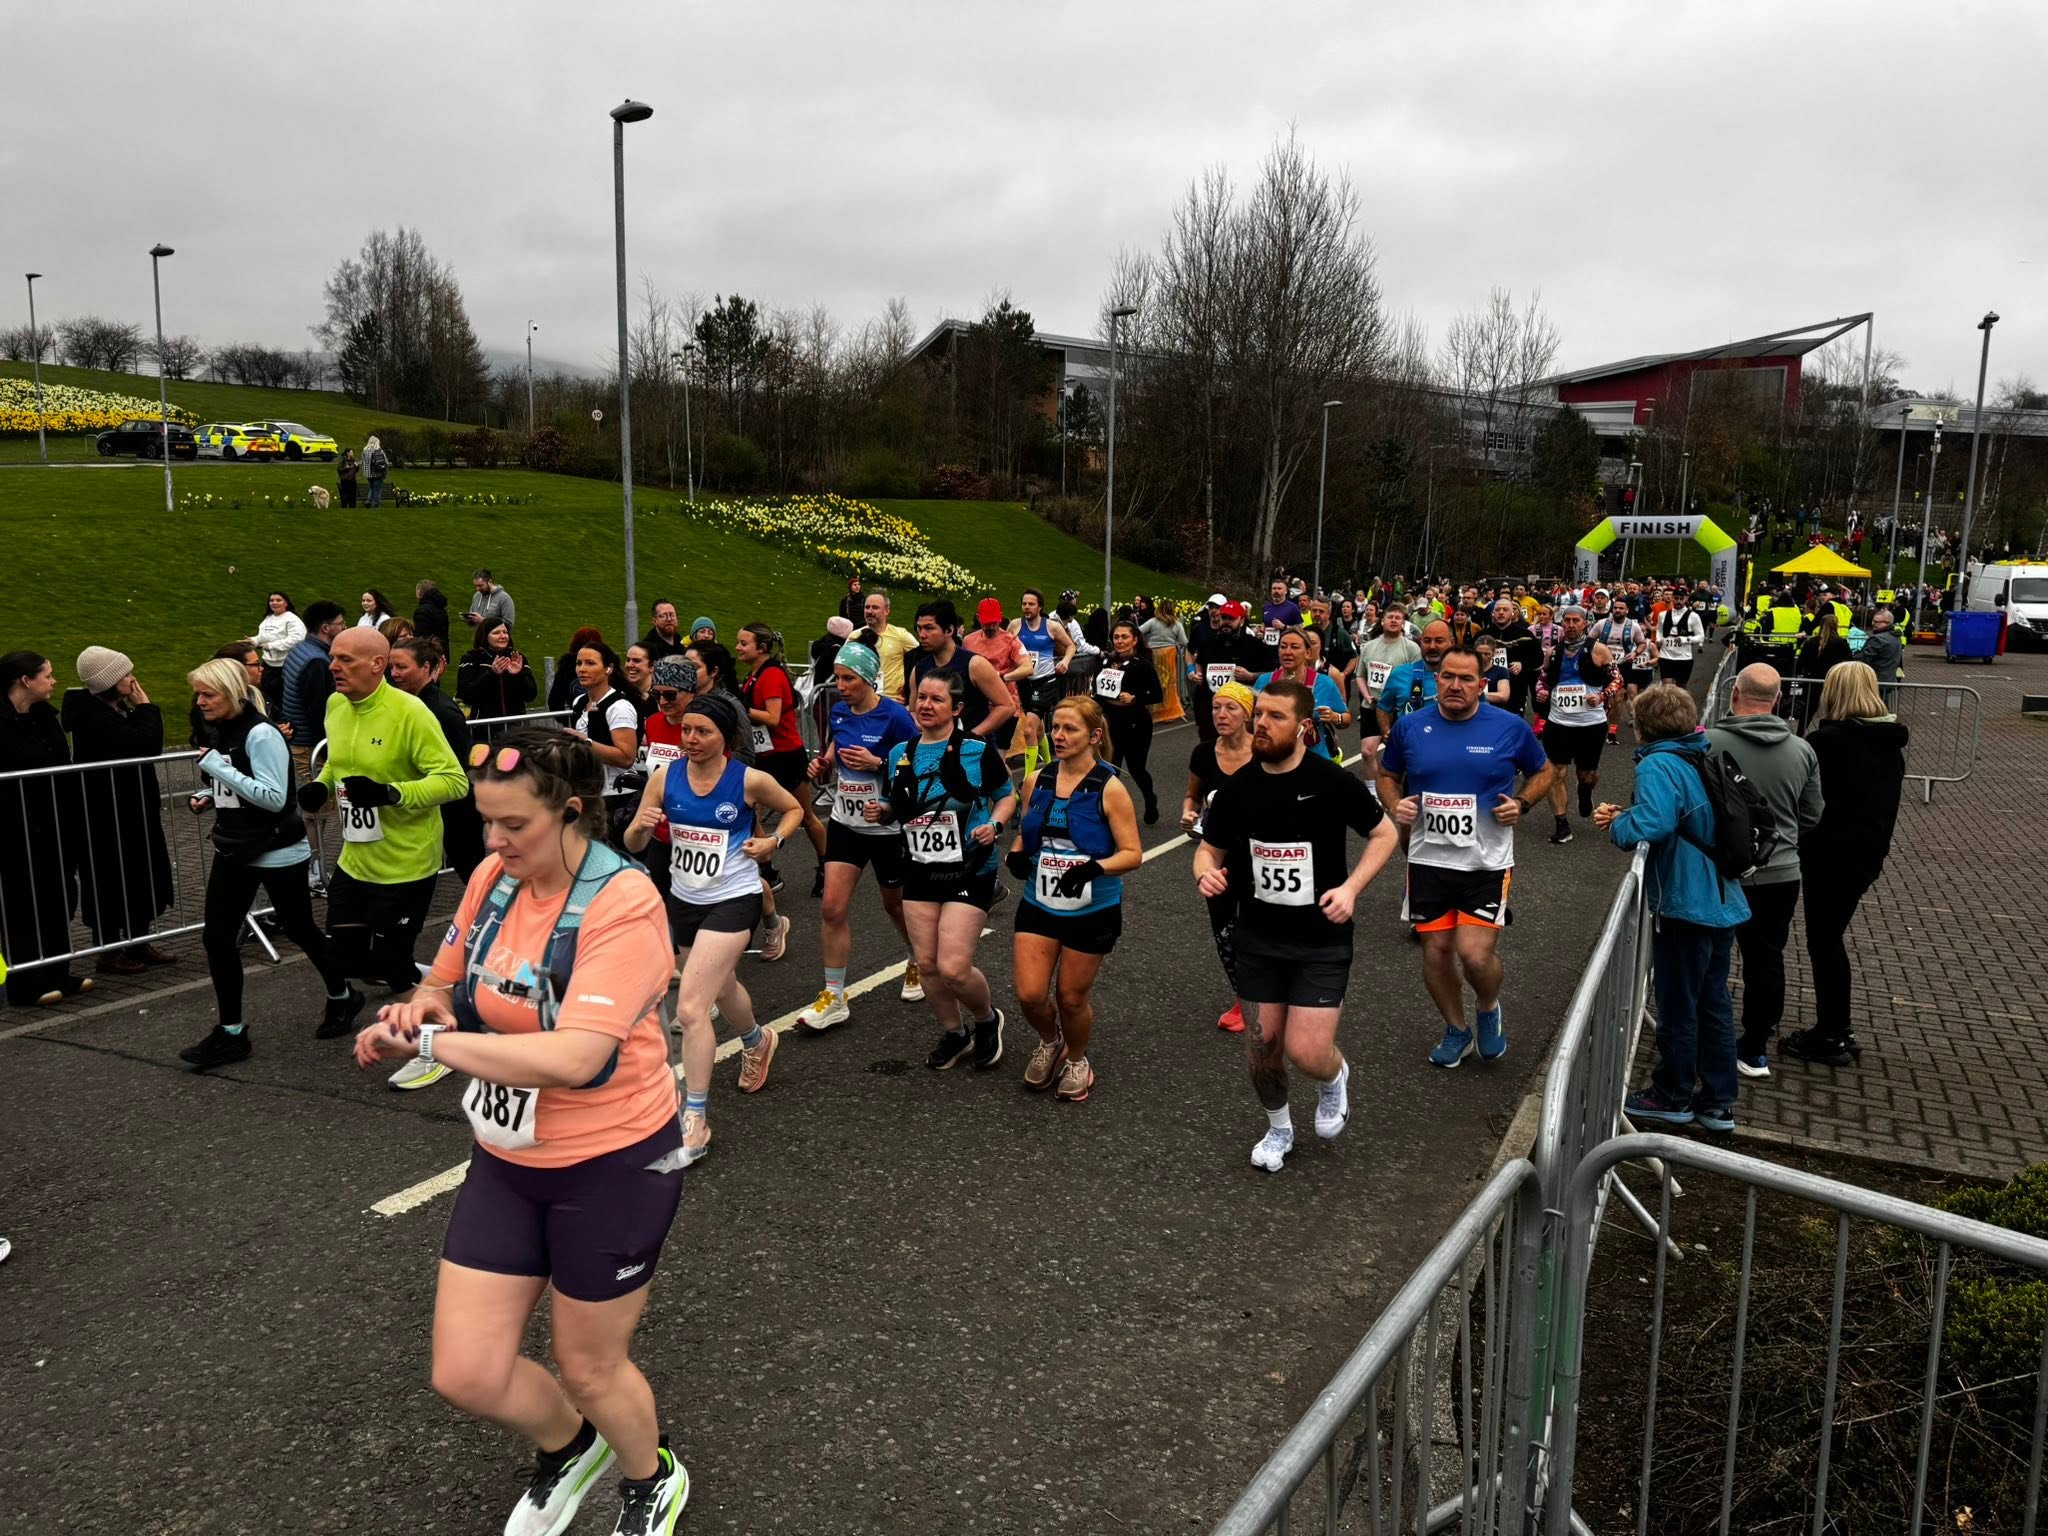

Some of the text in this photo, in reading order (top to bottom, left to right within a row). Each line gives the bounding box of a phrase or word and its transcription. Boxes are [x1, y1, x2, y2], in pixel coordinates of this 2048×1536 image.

[1621, 522, 1691, 534] FINISH
[1101, 678, 1116, 691] 556
[1211, 675, 1230, 687] 507
[1557, 695, 1584, 707] 2051
[840, 796, 876, 817] 199
[1424, 797, 1471, 807] GOGAR
[1426, 813, 1473, 835] 2003
[674, 828, 720, 843] GOGAR
[911, 831, 957, 852] 1284
[1254, 846, 1305, 858] GOGAR
[674, 846, 720, 877] 2000
[1261, 866, 1301, 893] 555
